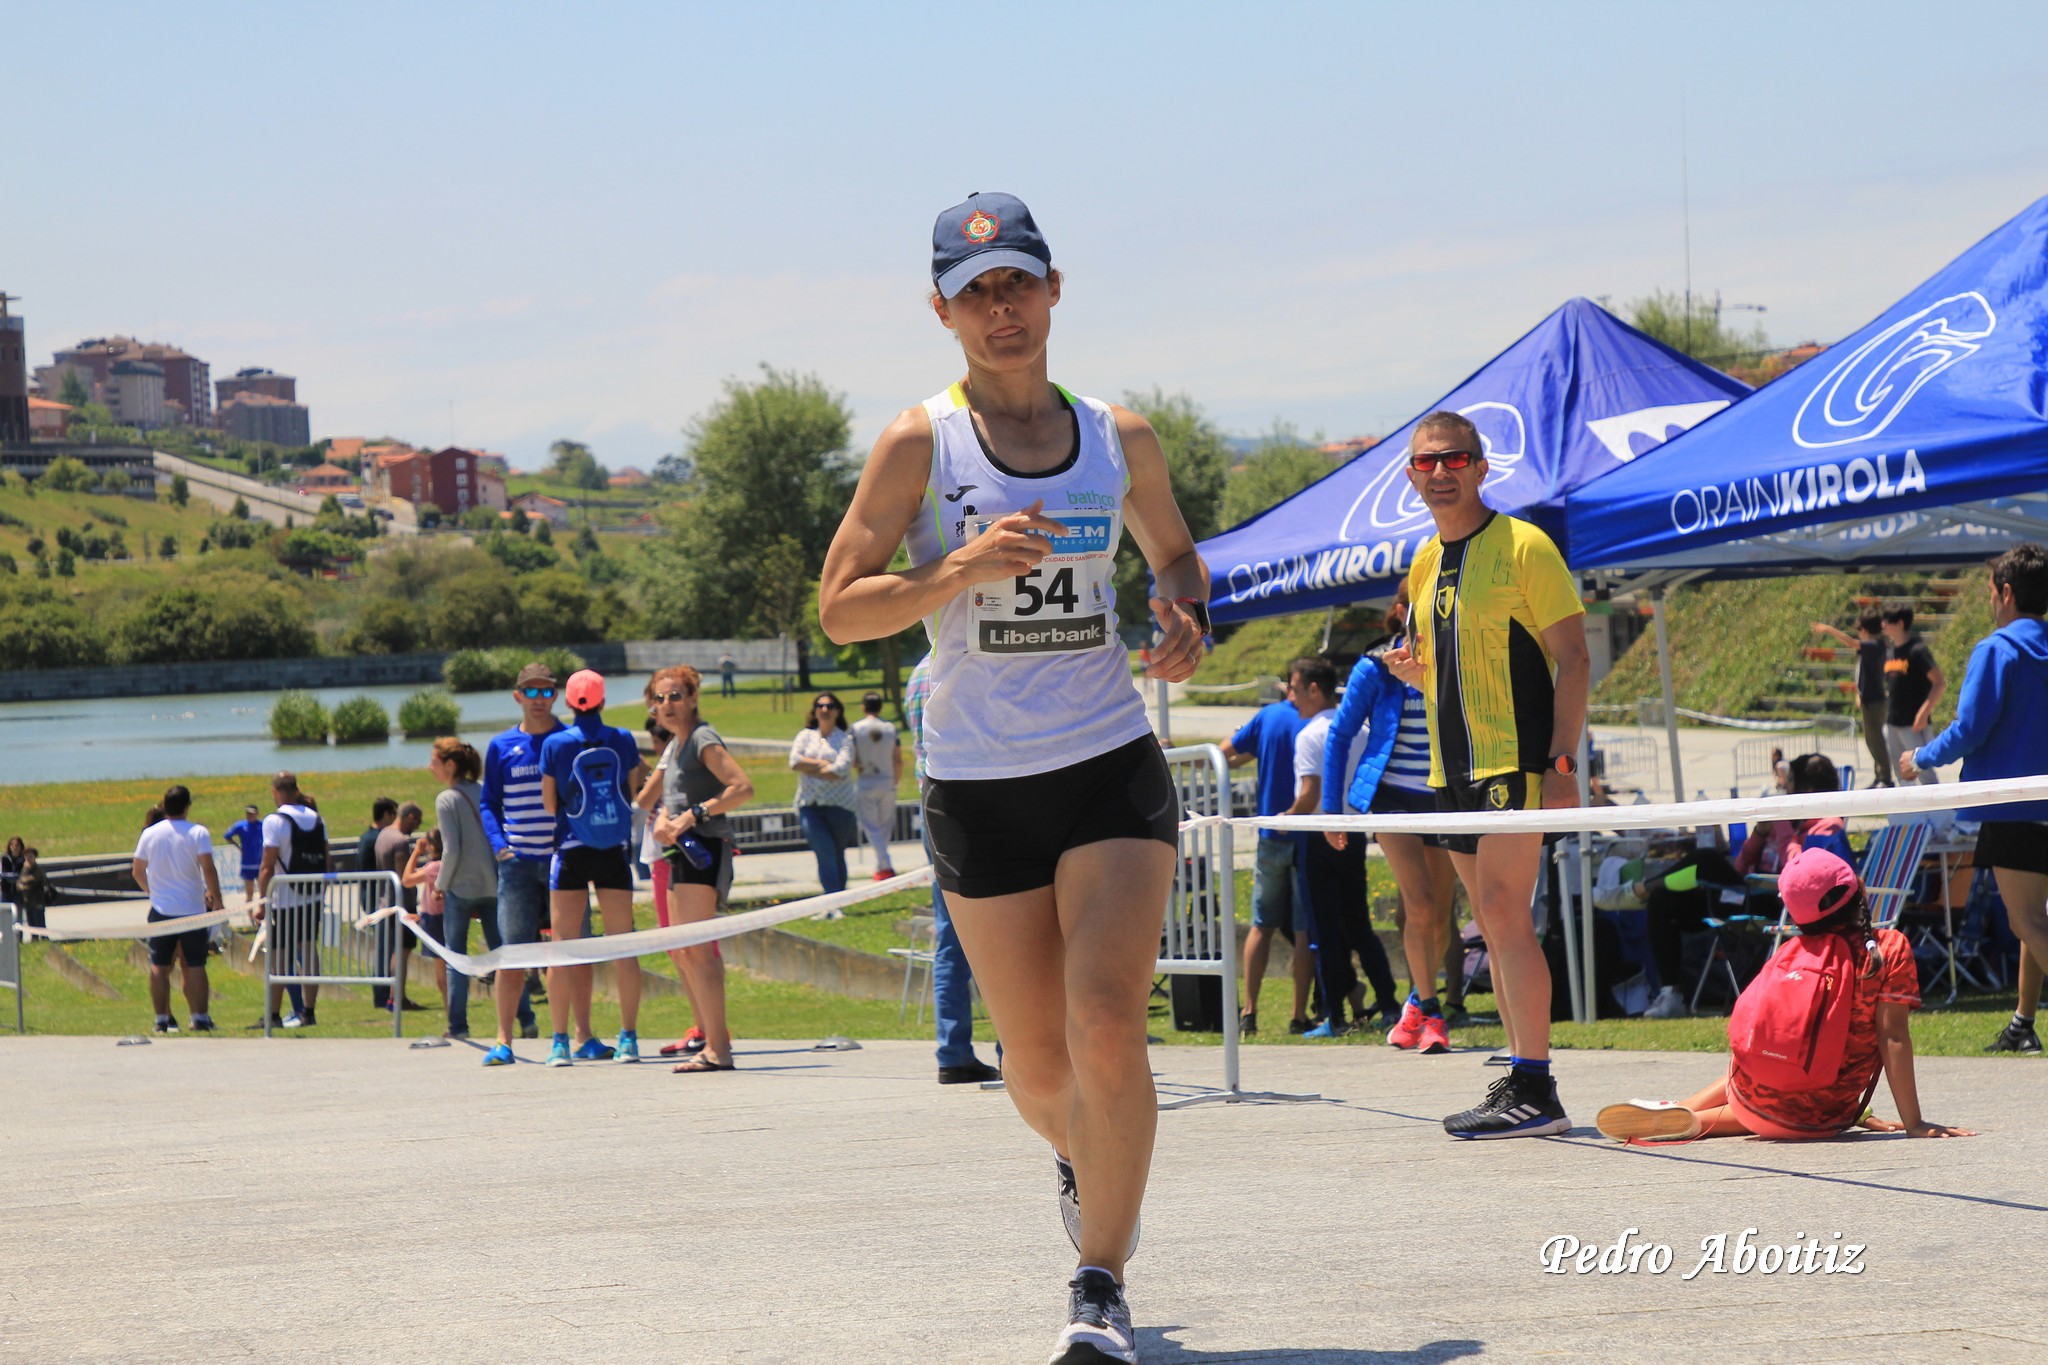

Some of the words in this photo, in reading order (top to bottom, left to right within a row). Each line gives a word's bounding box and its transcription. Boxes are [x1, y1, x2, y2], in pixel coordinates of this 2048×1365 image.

[1066, 489, 1115, 507] bathco
[1671, 449, 1926, 534] ORAINKIROLA
[1014, 567, 1079, 616] 54
[989, 624, 1100, 645] Liberbank
